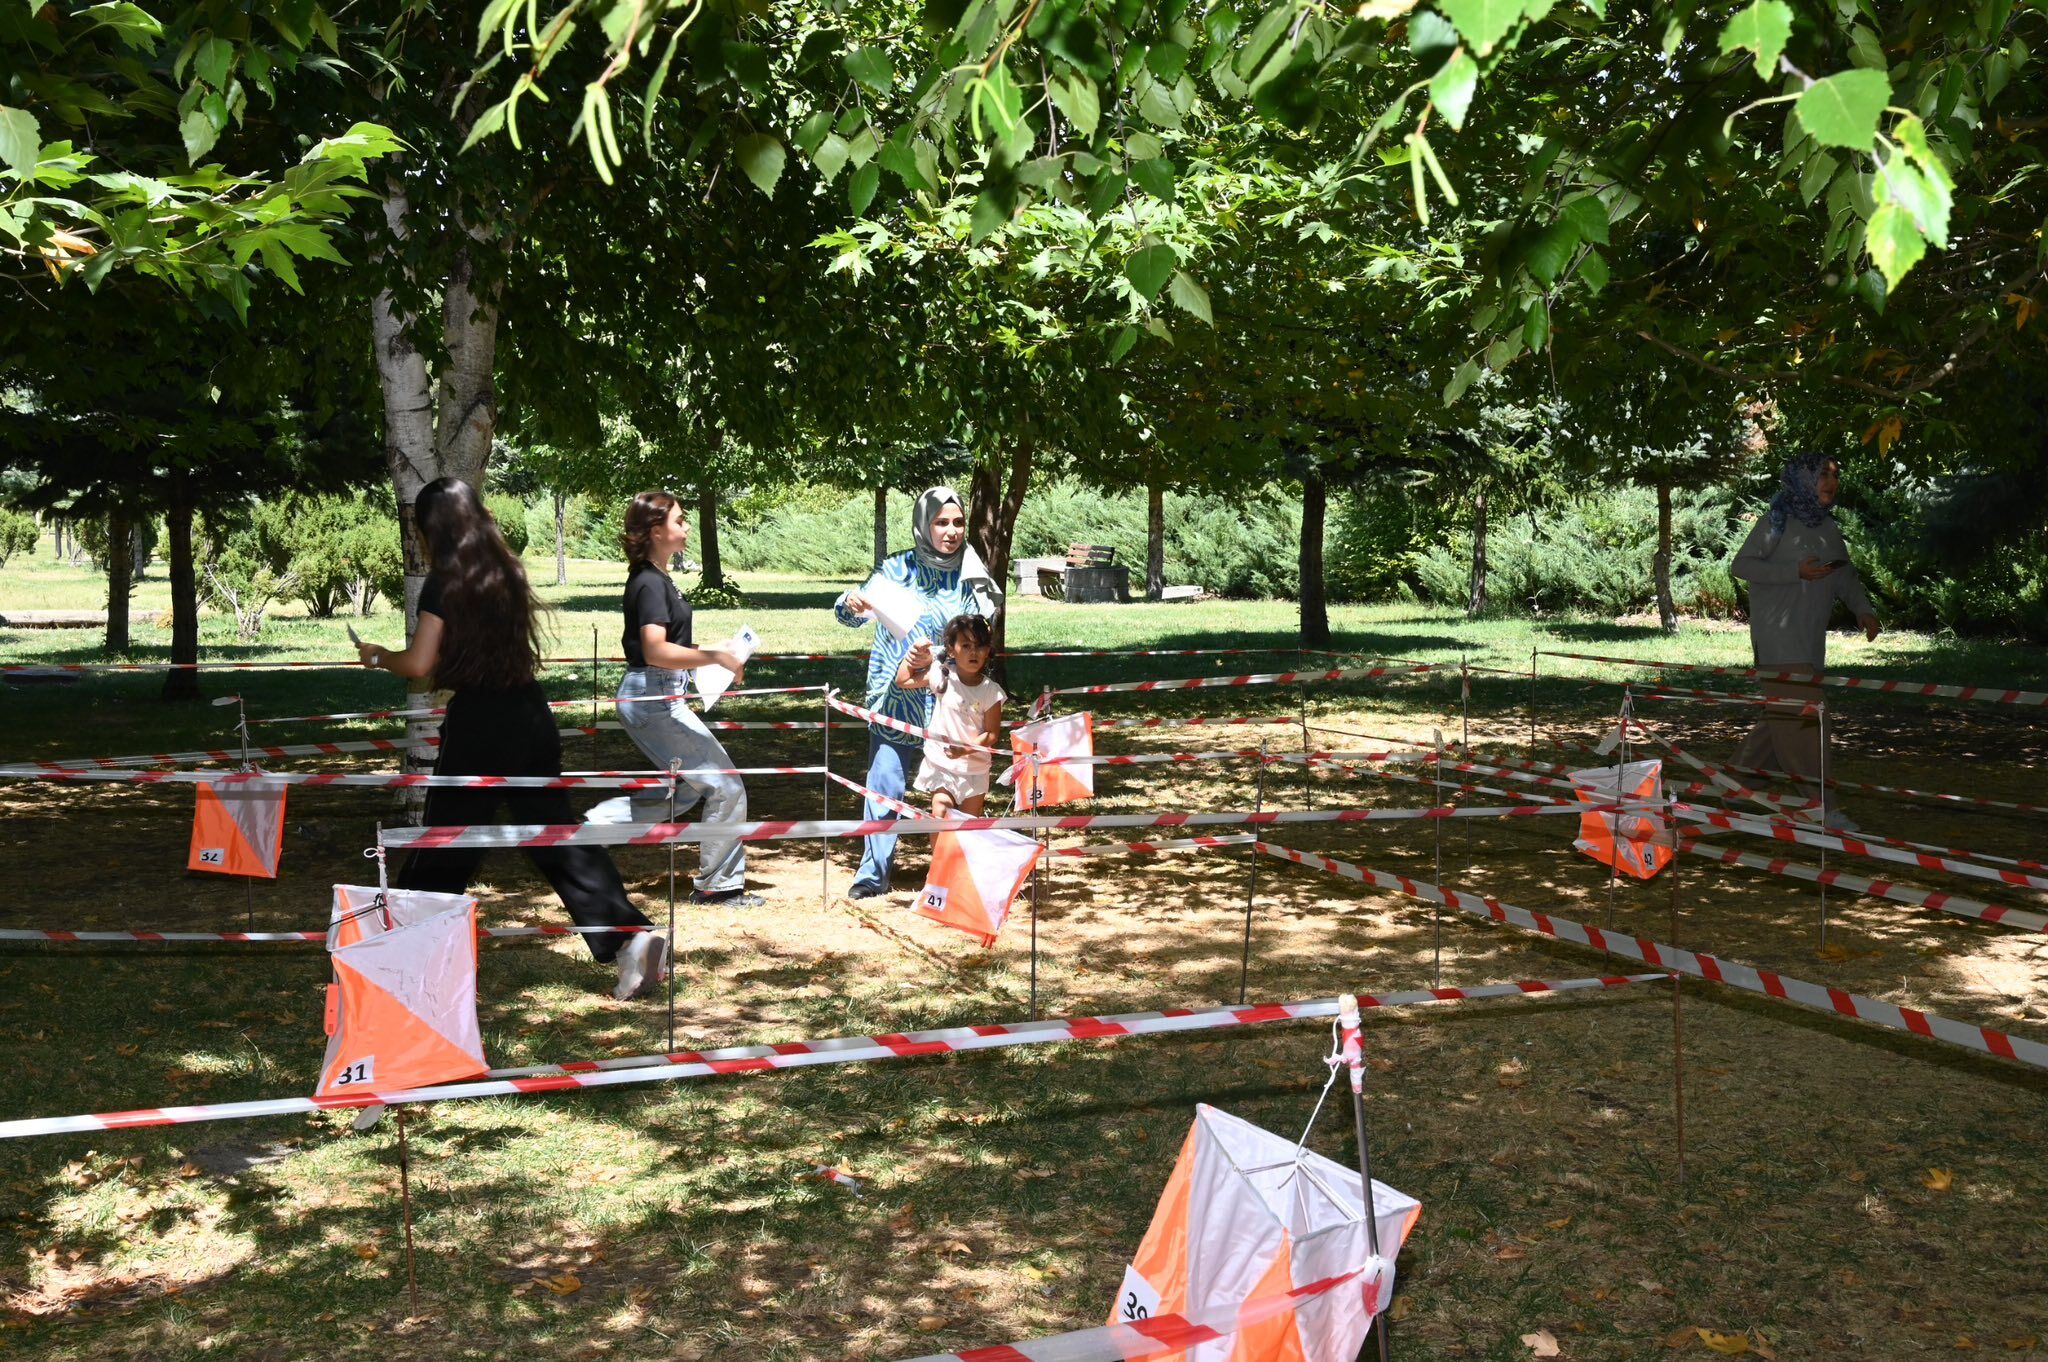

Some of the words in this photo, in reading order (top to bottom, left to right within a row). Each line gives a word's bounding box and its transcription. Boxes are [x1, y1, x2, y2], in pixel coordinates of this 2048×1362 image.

[201, 852, 218, 862] 32
[927, 894, 943, 907] 41
[338, 1063, 368, 1085] 31
